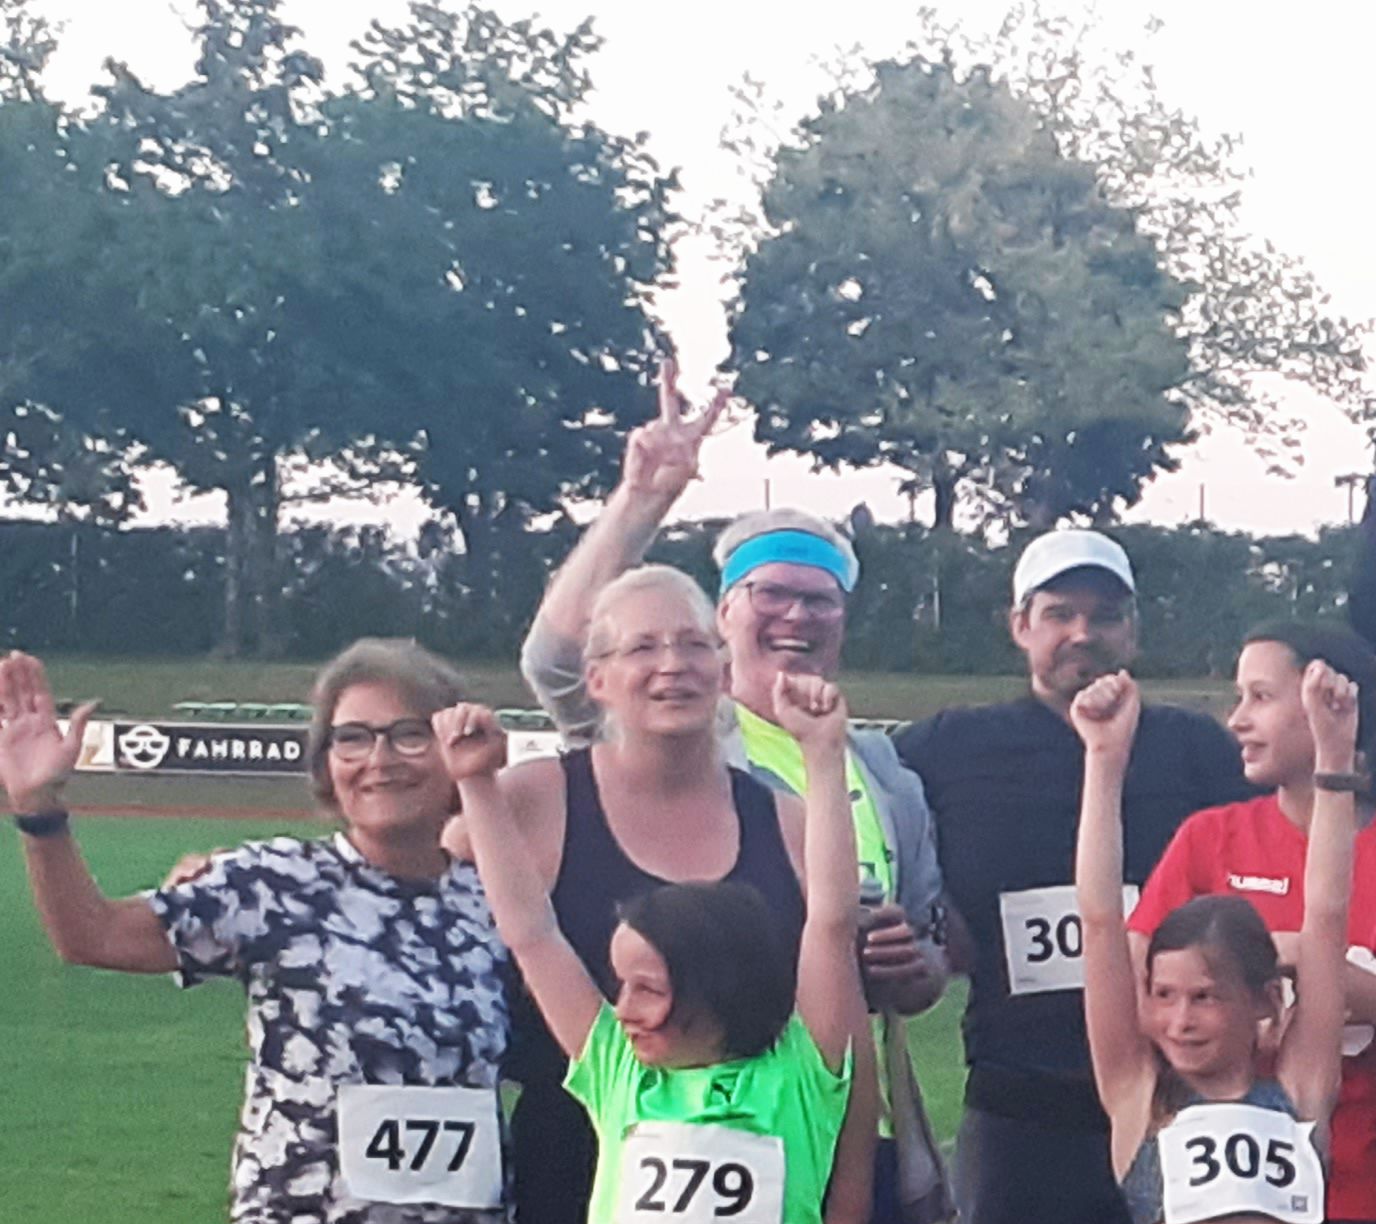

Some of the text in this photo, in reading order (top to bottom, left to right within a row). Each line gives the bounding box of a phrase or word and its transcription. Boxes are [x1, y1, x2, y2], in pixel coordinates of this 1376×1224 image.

[177, 738, 301, 760] FAHRRAD
[1025, 913, 1083, 962] 30
[365, 1119, 475, 1172] 477
[1185, 1133, 1296, 1188] 305
[635, 1157, 754, 1217] 279
